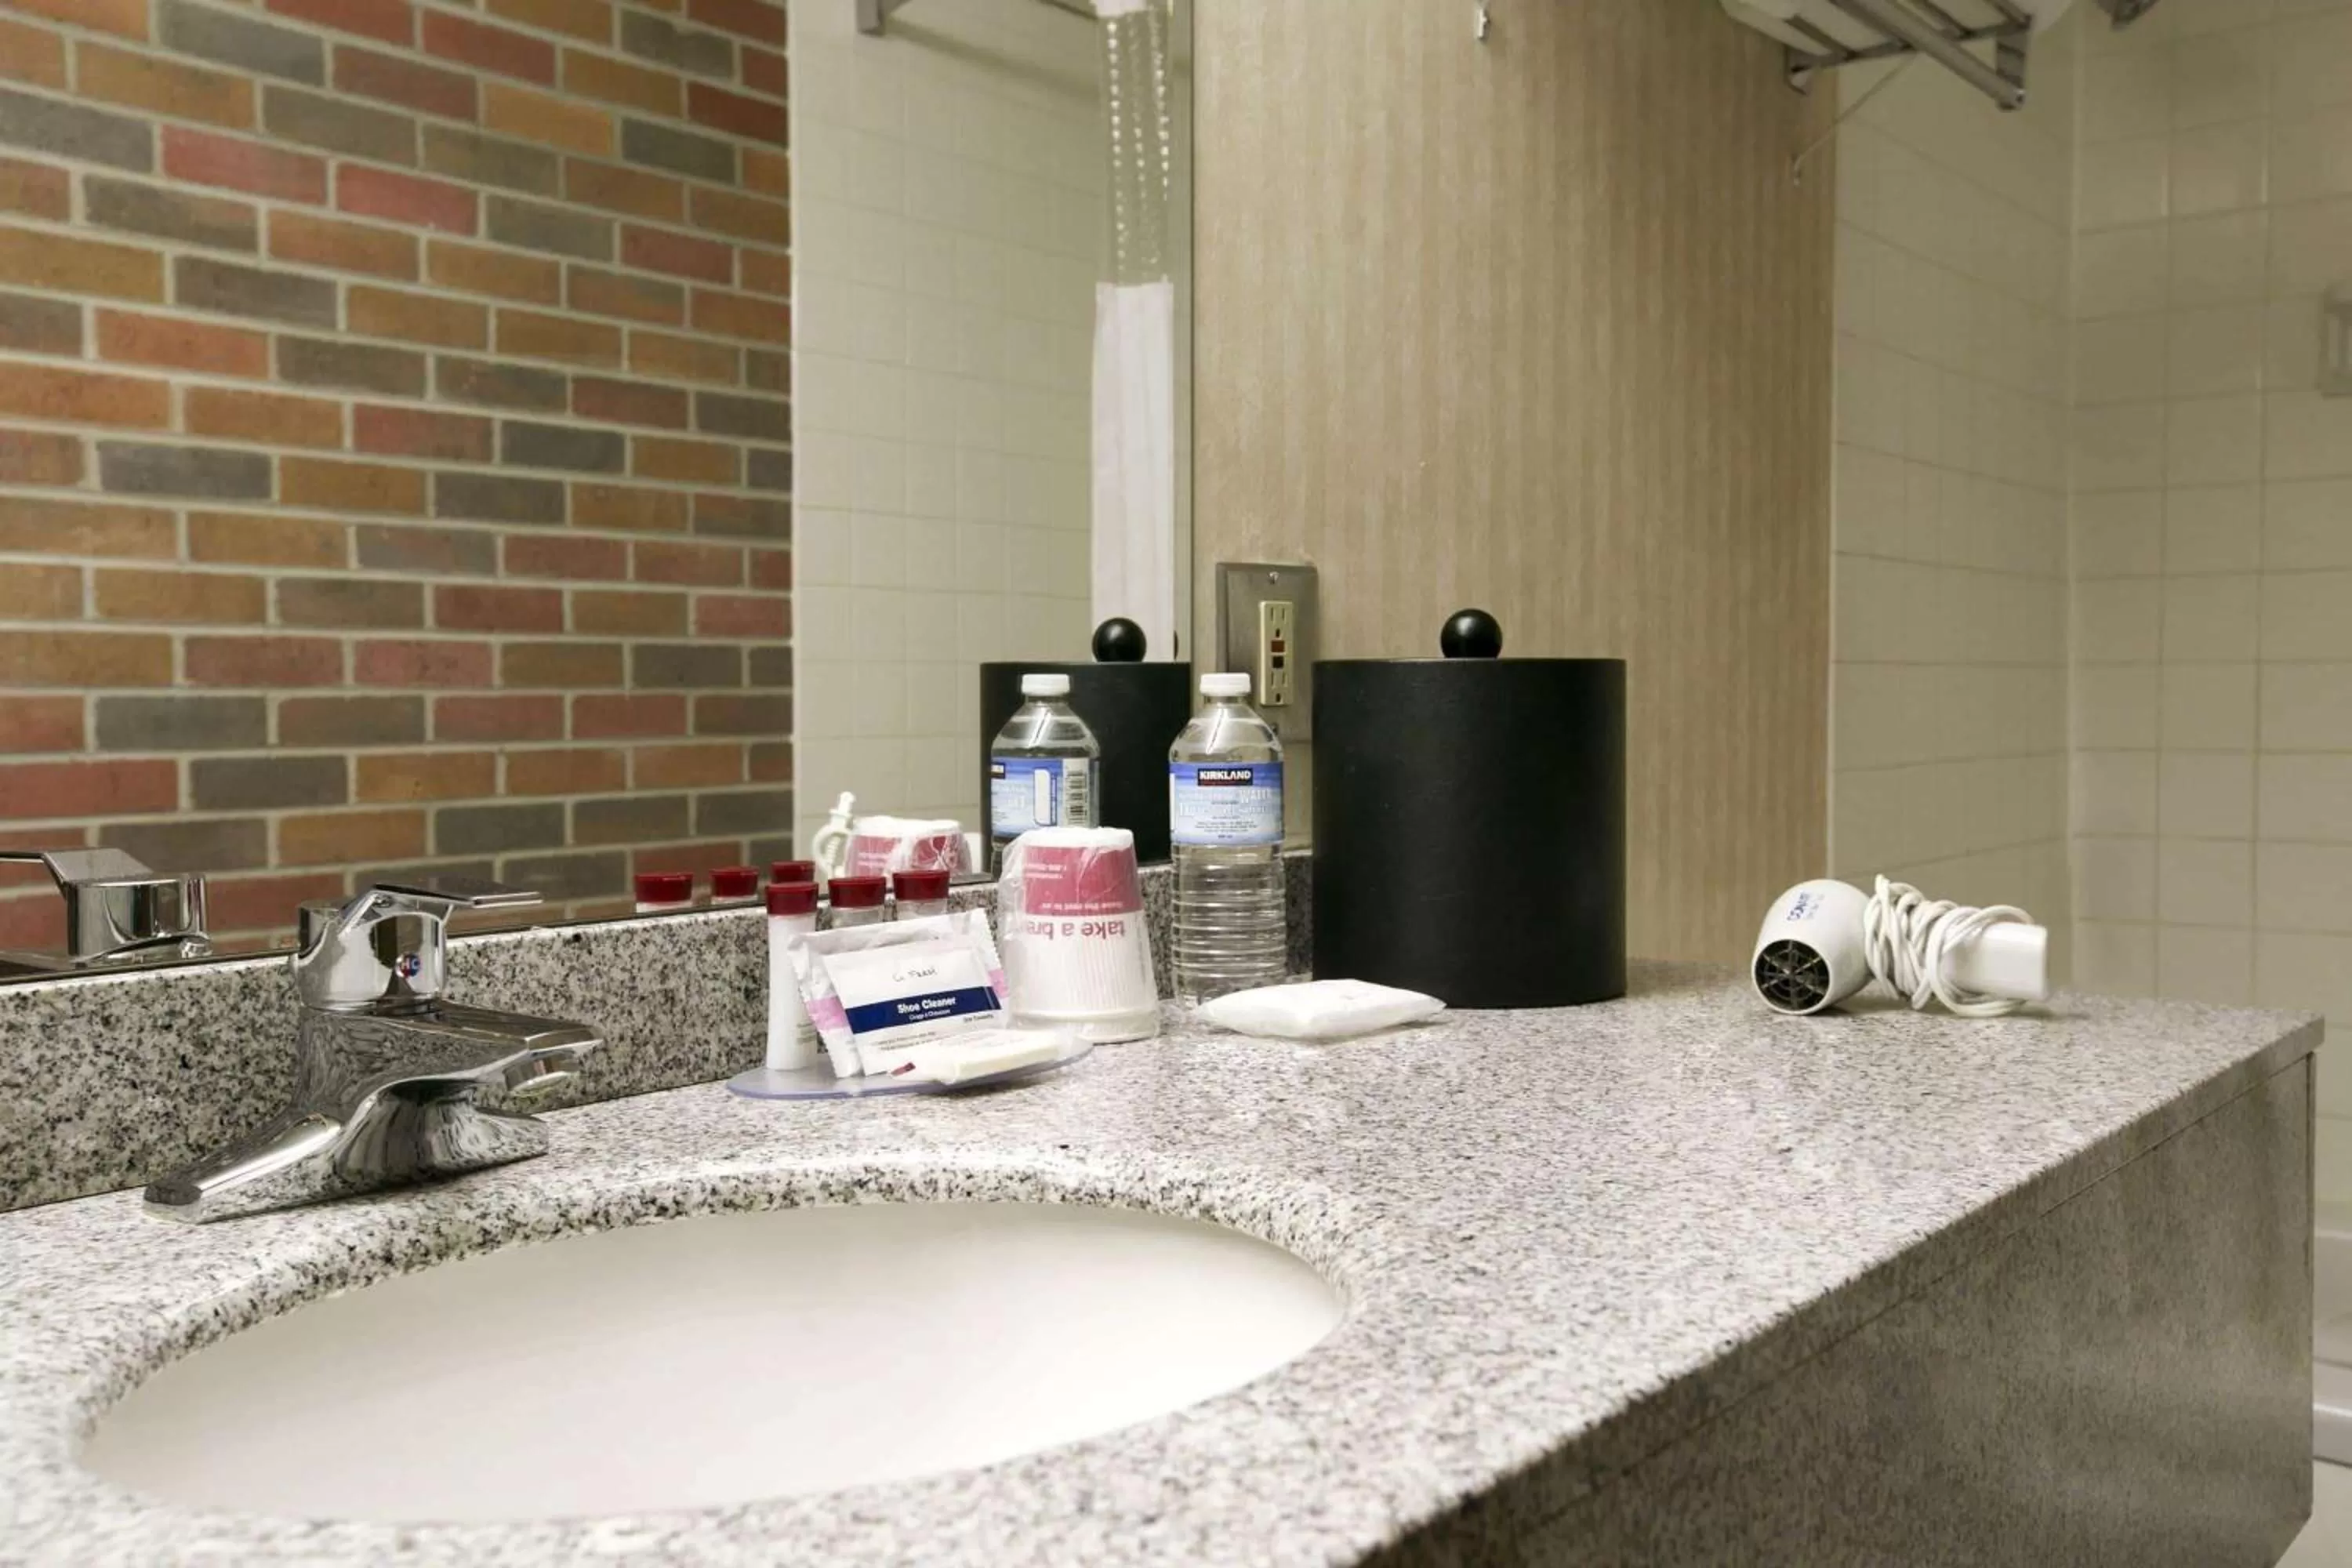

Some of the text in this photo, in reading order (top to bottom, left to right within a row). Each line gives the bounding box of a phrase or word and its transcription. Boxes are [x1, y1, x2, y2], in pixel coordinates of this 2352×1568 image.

[1200, 771, 1251, 780] KIRKLAND
[1061, 921, 1075, 937] a
[1081, 920, 1125, 940] take
[897, 996, 956, 1014] Shoe Cleaner
